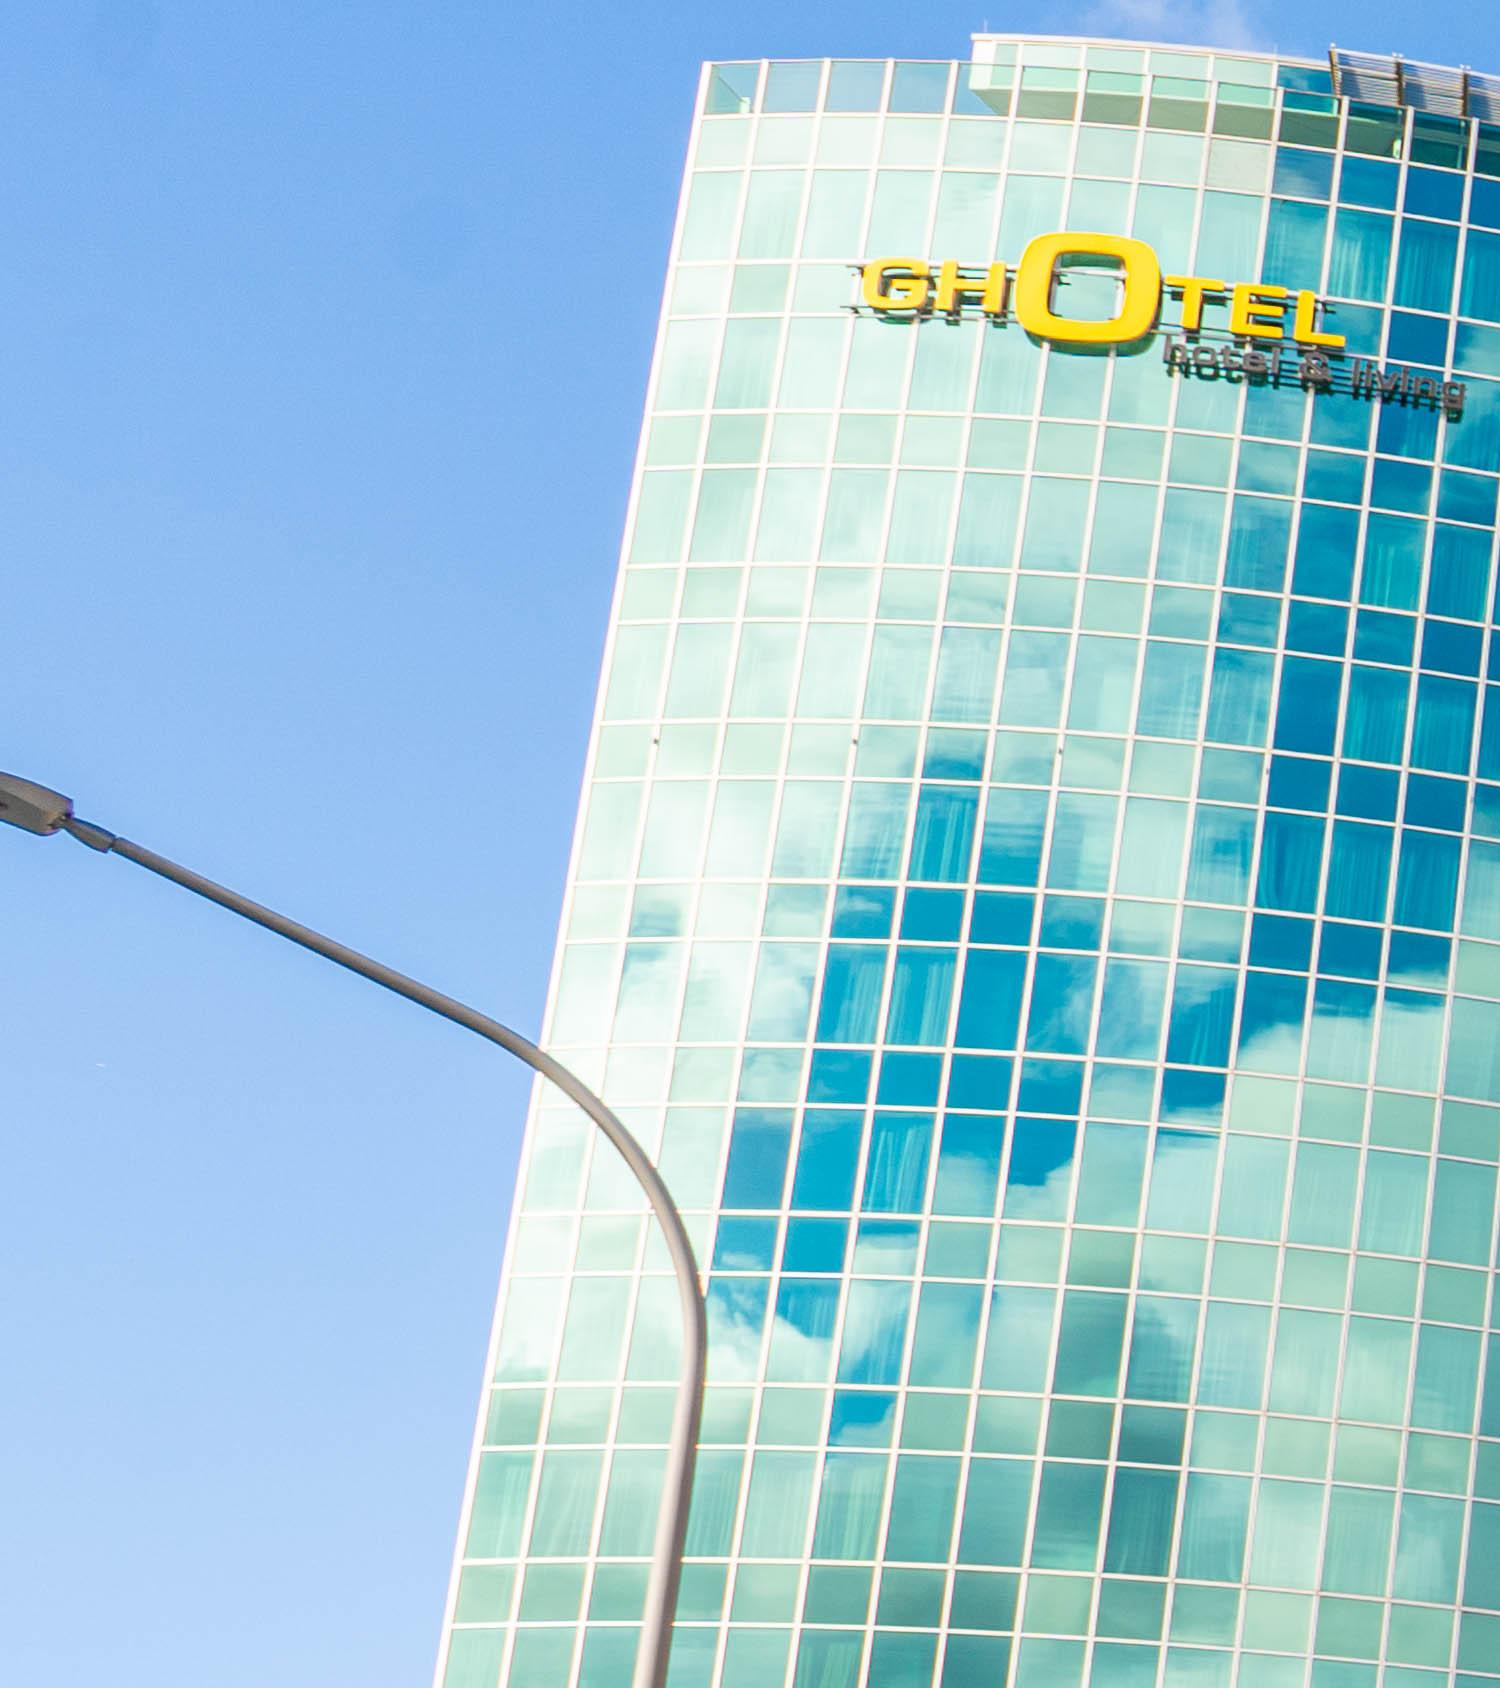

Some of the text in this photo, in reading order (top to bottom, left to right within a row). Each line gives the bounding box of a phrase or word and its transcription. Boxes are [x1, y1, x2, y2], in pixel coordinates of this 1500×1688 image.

[861, 231, 1347, 348] GHOTEL
[1163, 336, 1467, 406] hotel & living
